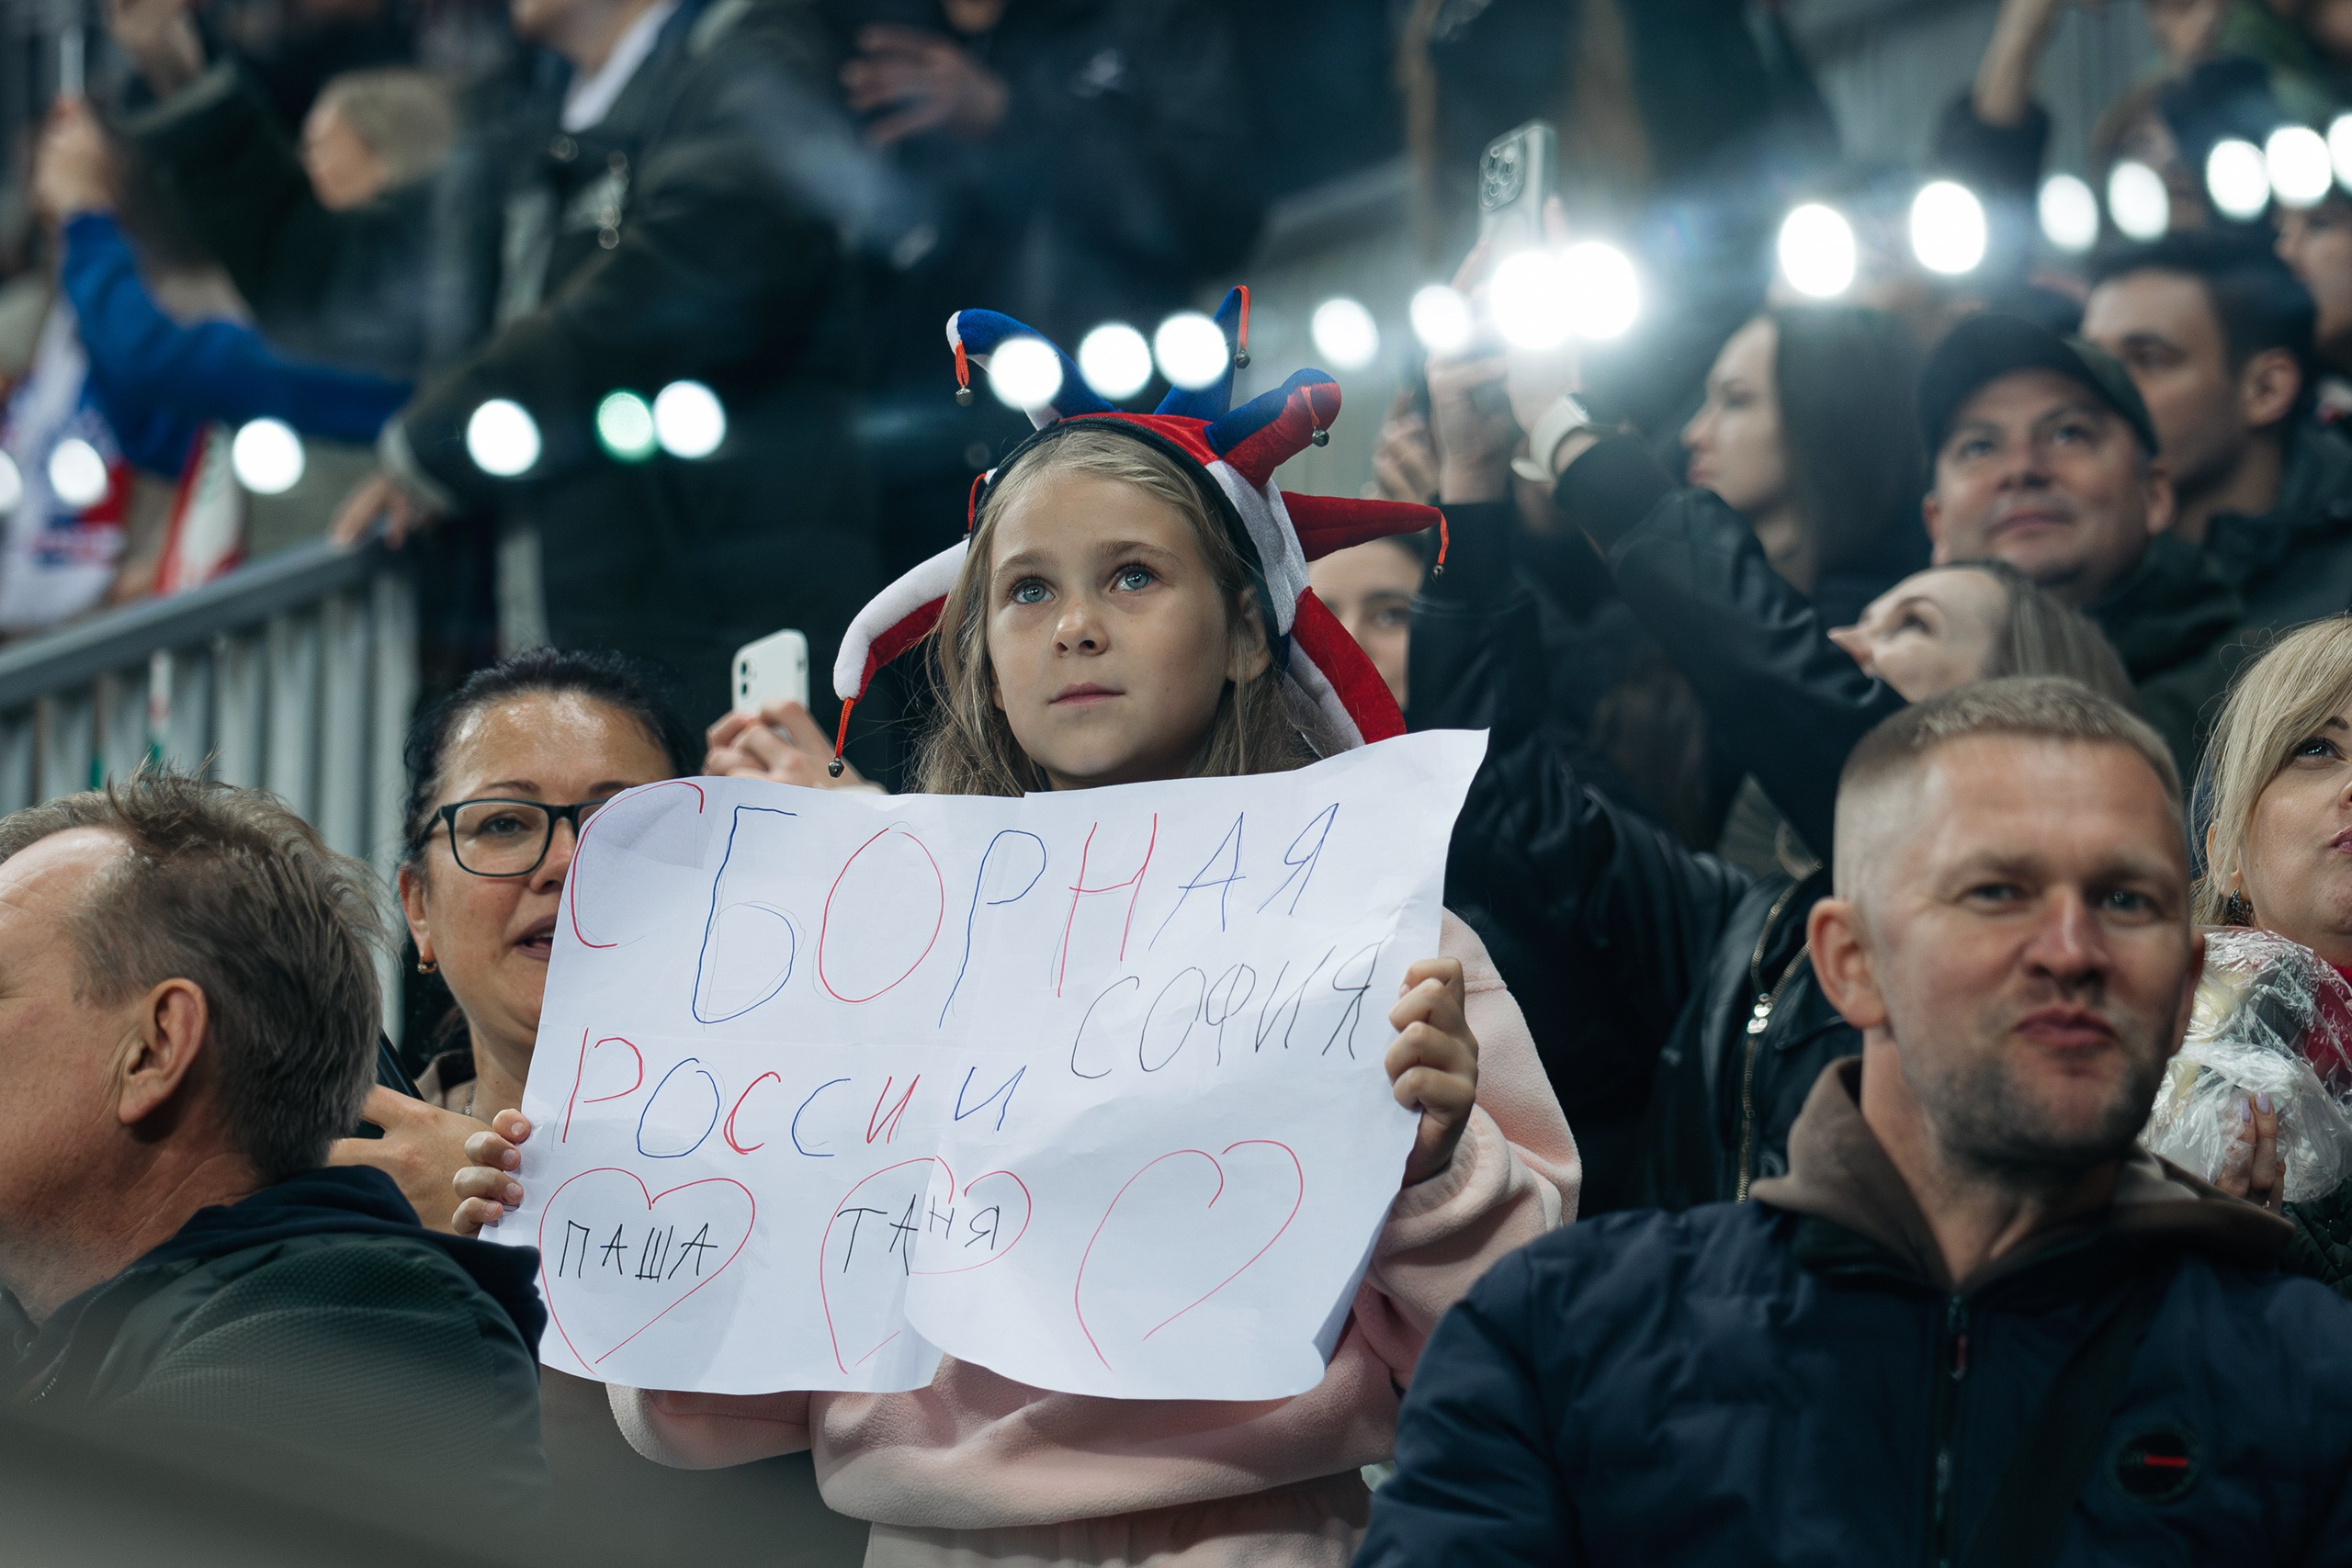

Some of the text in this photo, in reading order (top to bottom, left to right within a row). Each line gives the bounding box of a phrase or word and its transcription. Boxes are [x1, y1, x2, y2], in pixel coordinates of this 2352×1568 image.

[571, 780, 1340, 1029] СБОРНАЯ
[1071, 939, 1385, 1079] СОФИЯ
[560, 1026, 1028, 1158] РОССИИ
[559, 1219, 719, 1283] ПАША
[836, 1194, 1001, 1278] ТАНЯ
